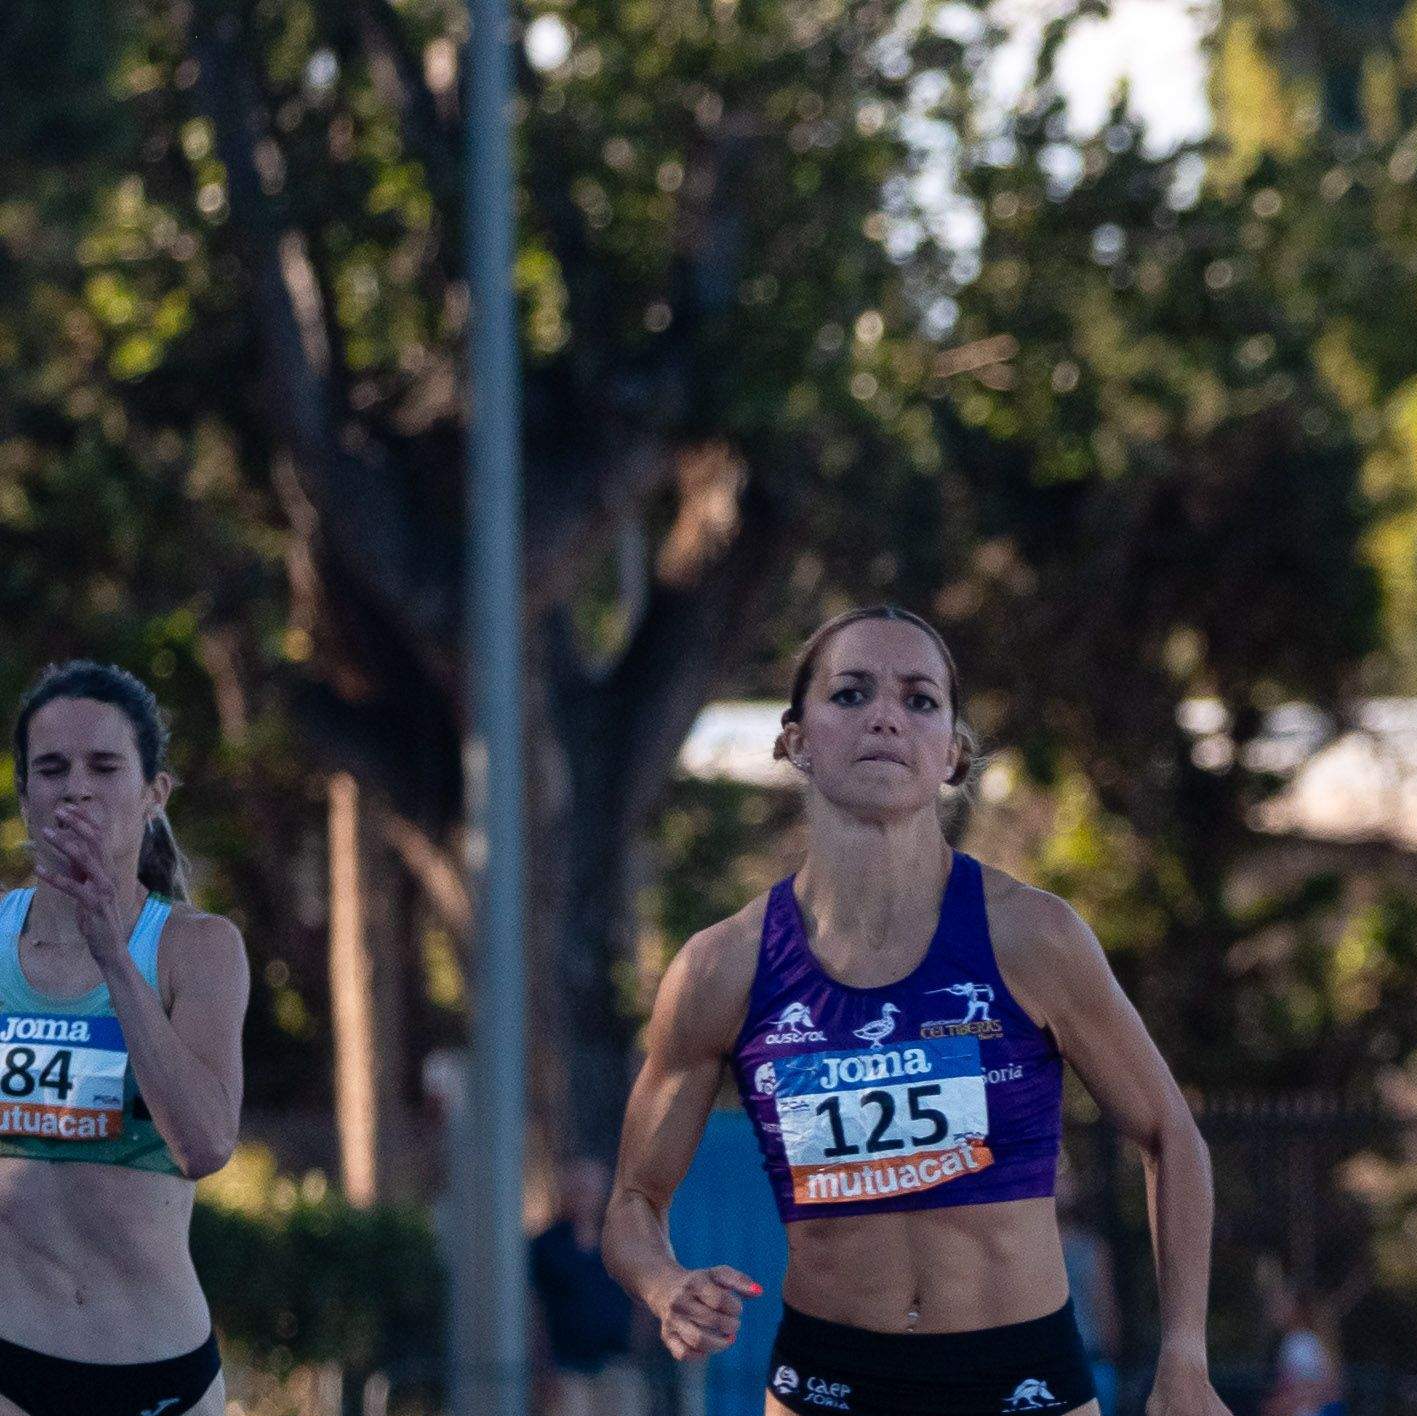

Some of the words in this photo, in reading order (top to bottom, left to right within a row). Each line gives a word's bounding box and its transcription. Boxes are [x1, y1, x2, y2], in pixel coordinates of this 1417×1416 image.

[0, 1046, 73, 1100] 84
[819, 1048, 932, 1090] Joma
[815, 1083, 950, 1158] 125
[807, 1143, 978, 1198] mutuacat
